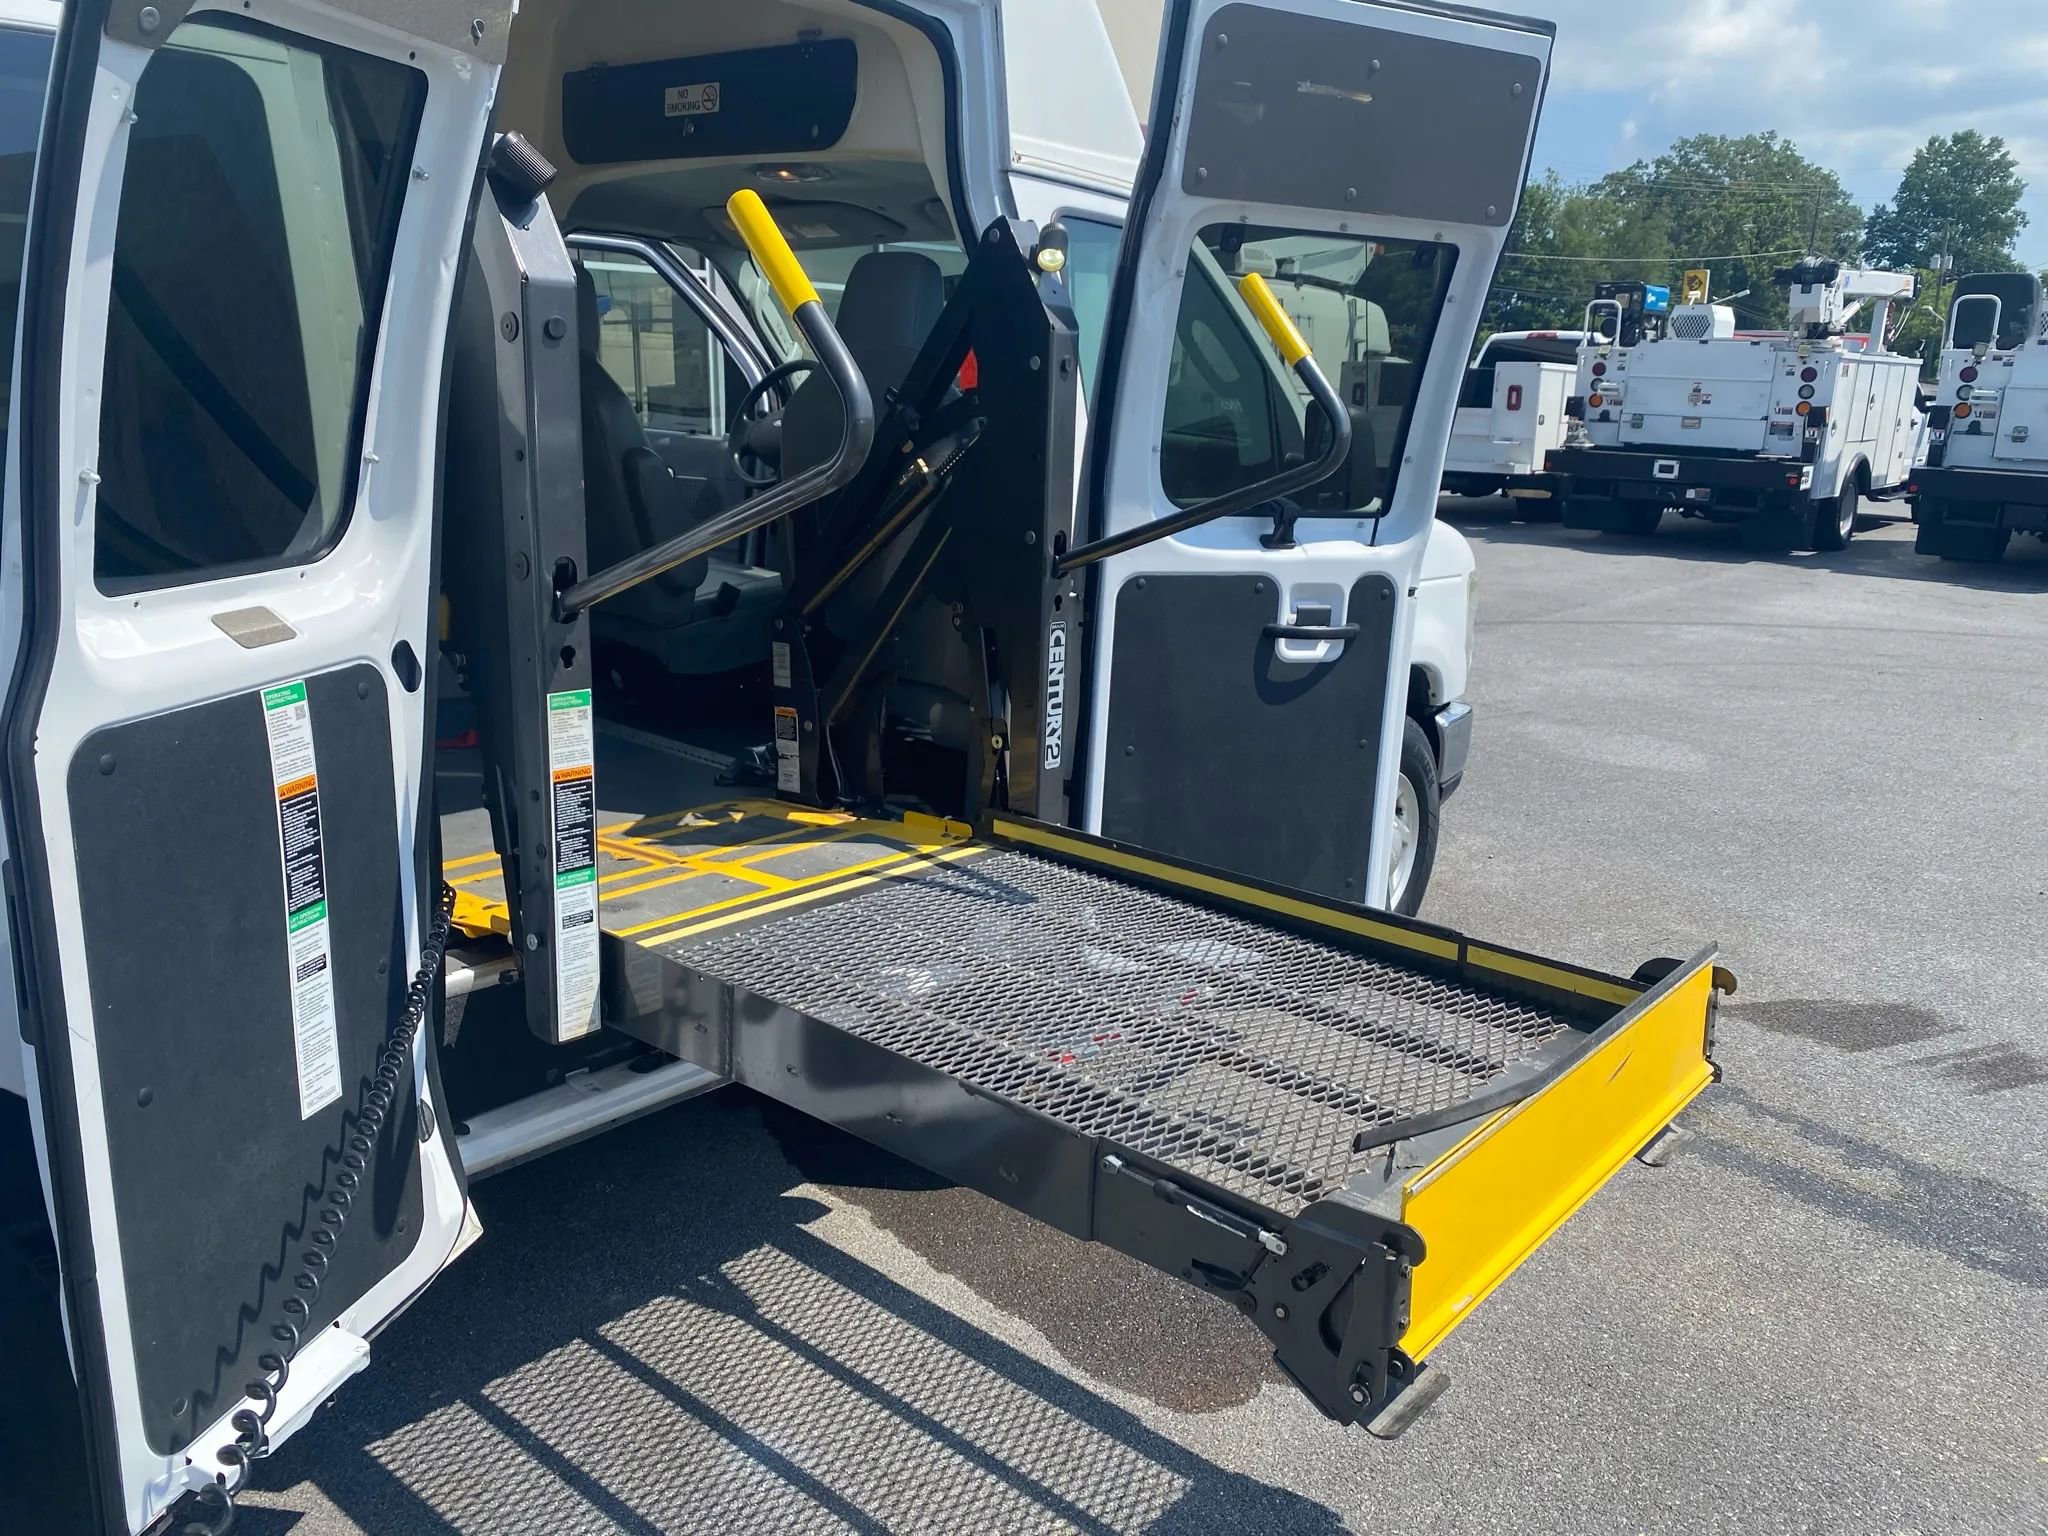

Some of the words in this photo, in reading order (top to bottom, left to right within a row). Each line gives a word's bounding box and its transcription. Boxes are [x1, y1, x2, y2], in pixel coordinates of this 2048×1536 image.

[678, 89, 689, 100] NO
[667, 101, 700, 113] SMOKING
[561, 768, 591, 778] WARNING
[285, 778, 315, 793] WARNING
